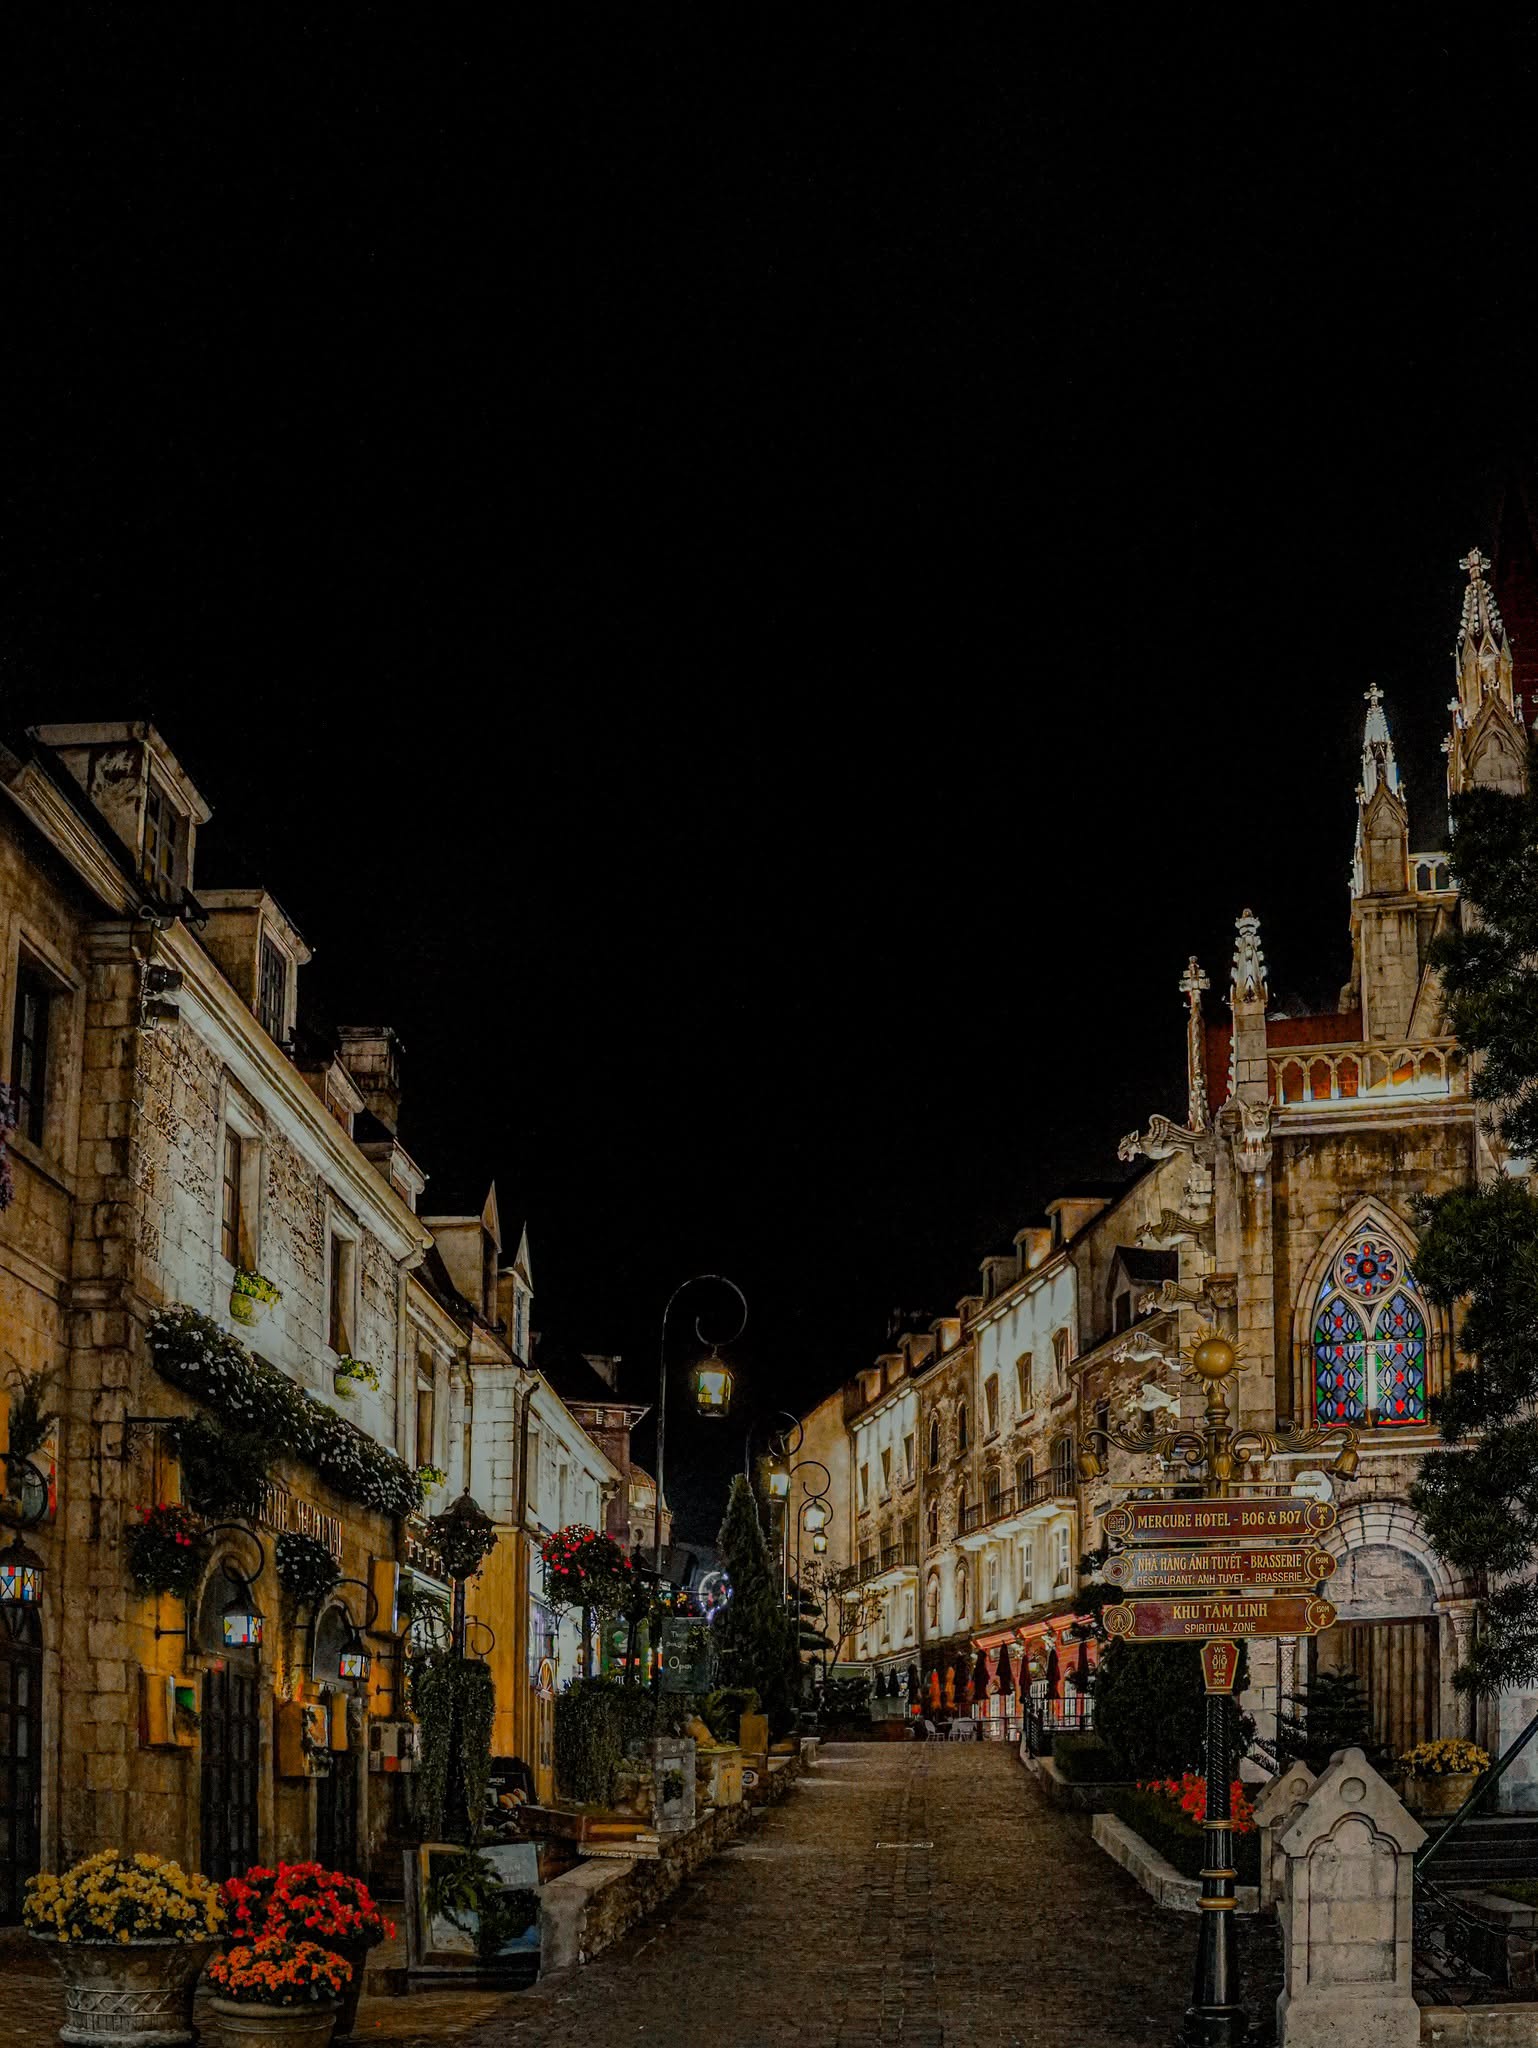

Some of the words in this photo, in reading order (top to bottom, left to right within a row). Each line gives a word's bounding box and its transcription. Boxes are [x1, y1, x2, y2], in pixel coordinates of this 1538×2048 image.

[1136, 1514, 1192, 1529] MERCURE
[1194, 1512, 1231, 1527] HOTEL
[1267, 1511, 1277, 1525] &
[1138, 1553, 1158, 1572] NHÀ
[1160, 1553, 1187, 1571] HÀNG
[1210, 1551, 1242, 1570] TUYẾT
[1250, 1554, 1302, 1569] BRASSERIE
[1197, 1573, 1216, 1585] ANH
[1217, 1573, 1245, 1584] TUYET
[1255, 1571, 1303, 1583] BRASSERIE
[1173, 1604, 1200, 1619] KHU
[1202, 1602, 1234, 1619] TÂM
[1237, 1603, 1268, 1617] LINH
[1184, 1622, 1231, 1634] SPIRITUAL
[1232, 1621, 1257, 1632] ZONE
